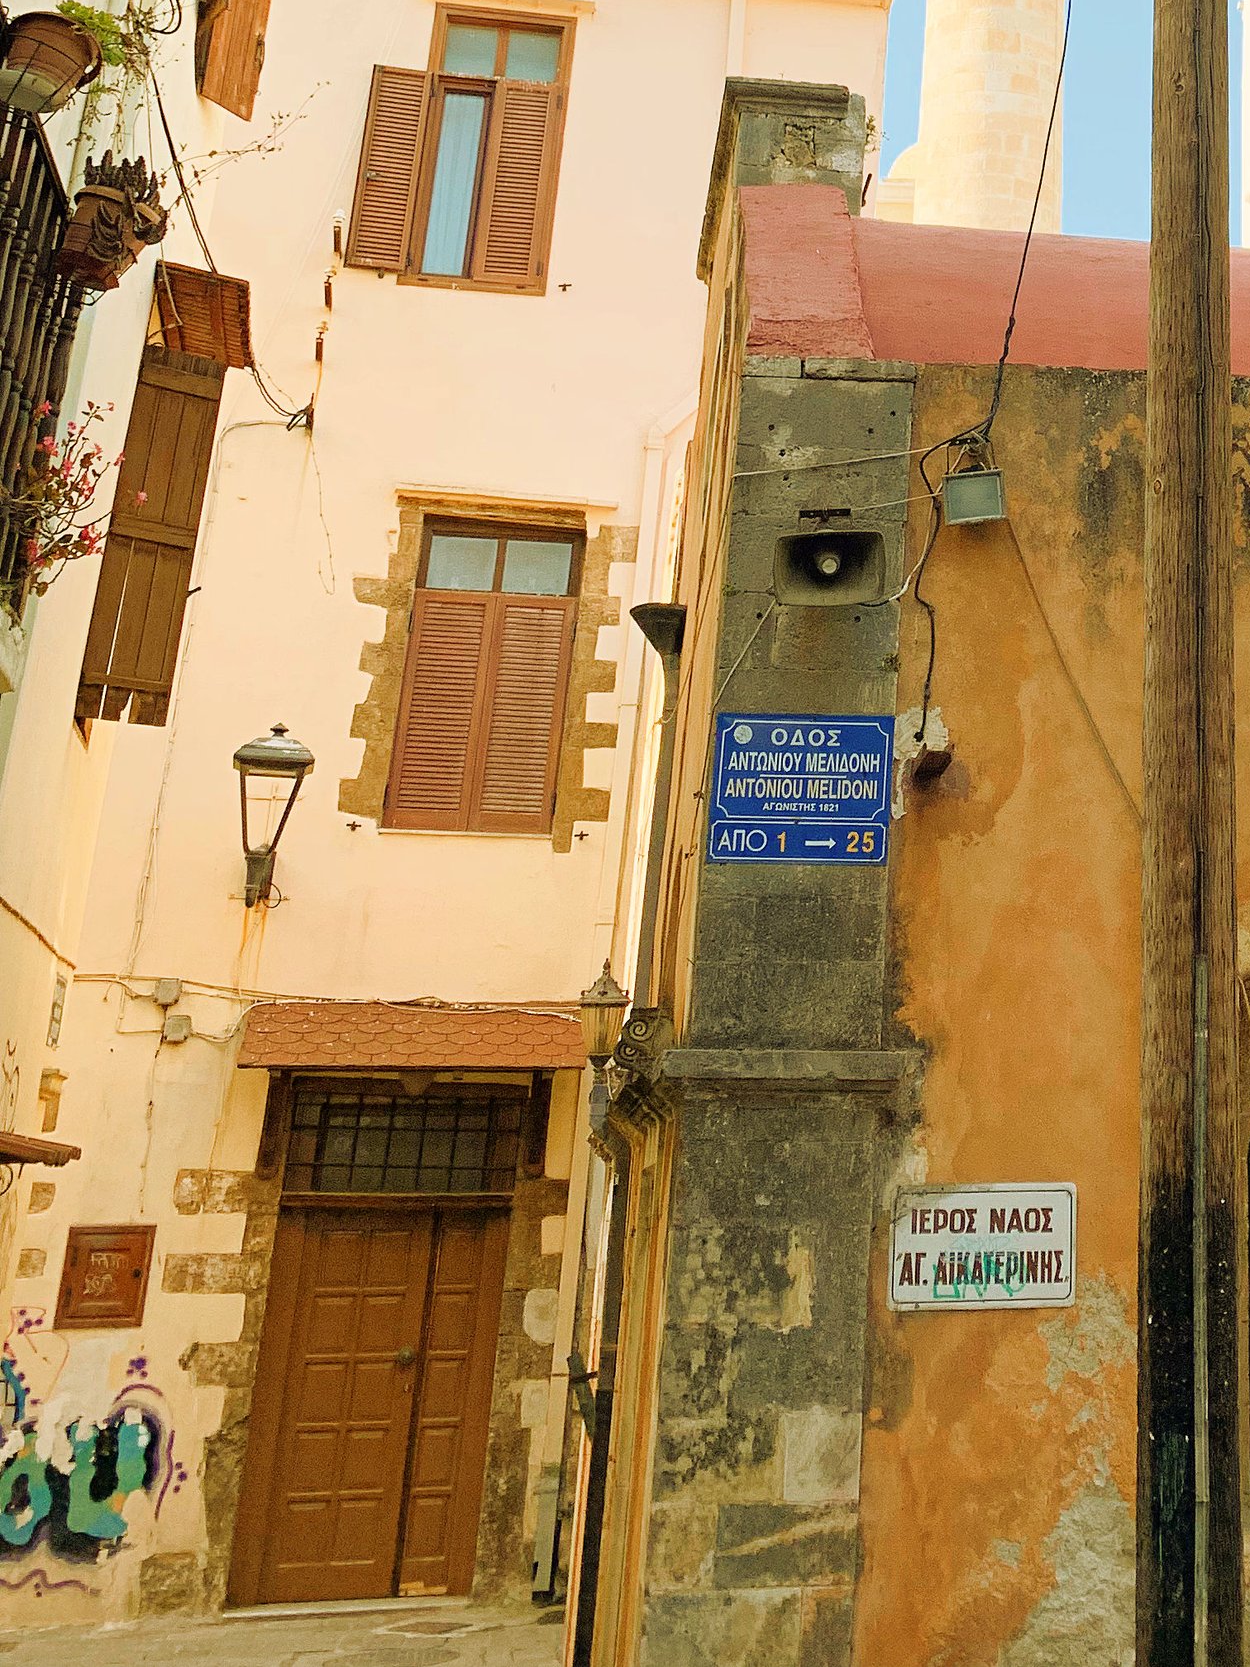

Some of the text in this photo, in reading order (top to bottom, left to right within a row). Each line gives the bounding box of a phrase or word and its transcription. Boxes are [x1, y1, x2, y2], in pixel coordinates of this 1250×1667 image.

[771, 728, 841, 746] ΟΔΟΣ
[728, 752, 880, 773] ΑΝΤΩΝΙΟΥ ΜΕΛΙΔΟΝΗ
[725, 778, 878, 799] ANTONIOU MELIDONI
[763, 802, 839, 812] ΑΓΩΝΙΣΤΗΣ 1821
[718, 829, 875, 853] ΑΠΟ 1 25
[911, 1207, 1054, 1234] ΙΕΡΟΣ ΝΑΟΣ
